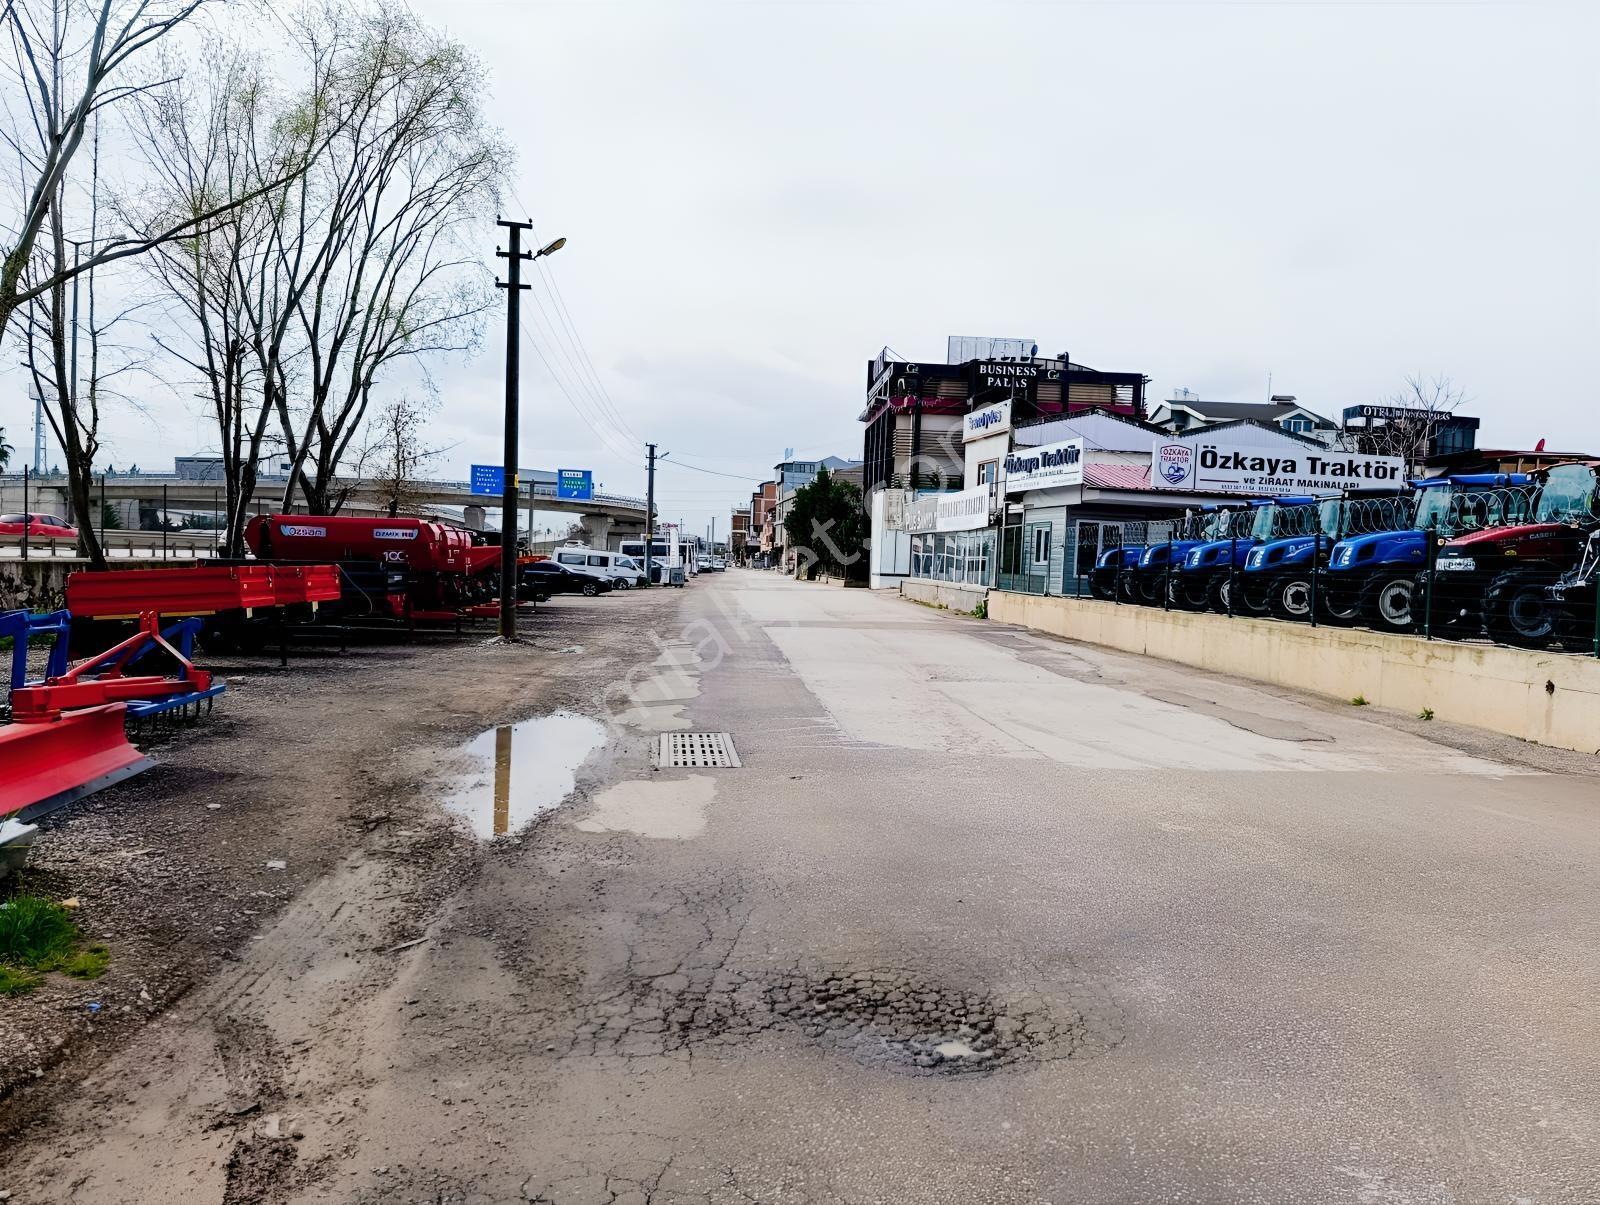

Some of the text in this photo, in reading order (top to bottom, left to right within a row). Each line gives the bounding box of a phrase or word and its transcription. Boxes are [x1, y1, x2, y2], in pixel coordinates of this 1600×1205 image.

[979, 364, 1037, 377] BUSINESS
[1040, 445, 1081, 469] Traktör
[1200, 445, 1400, 480] Özkaya Traktör
[1243, 477, 1256, 485] ve
